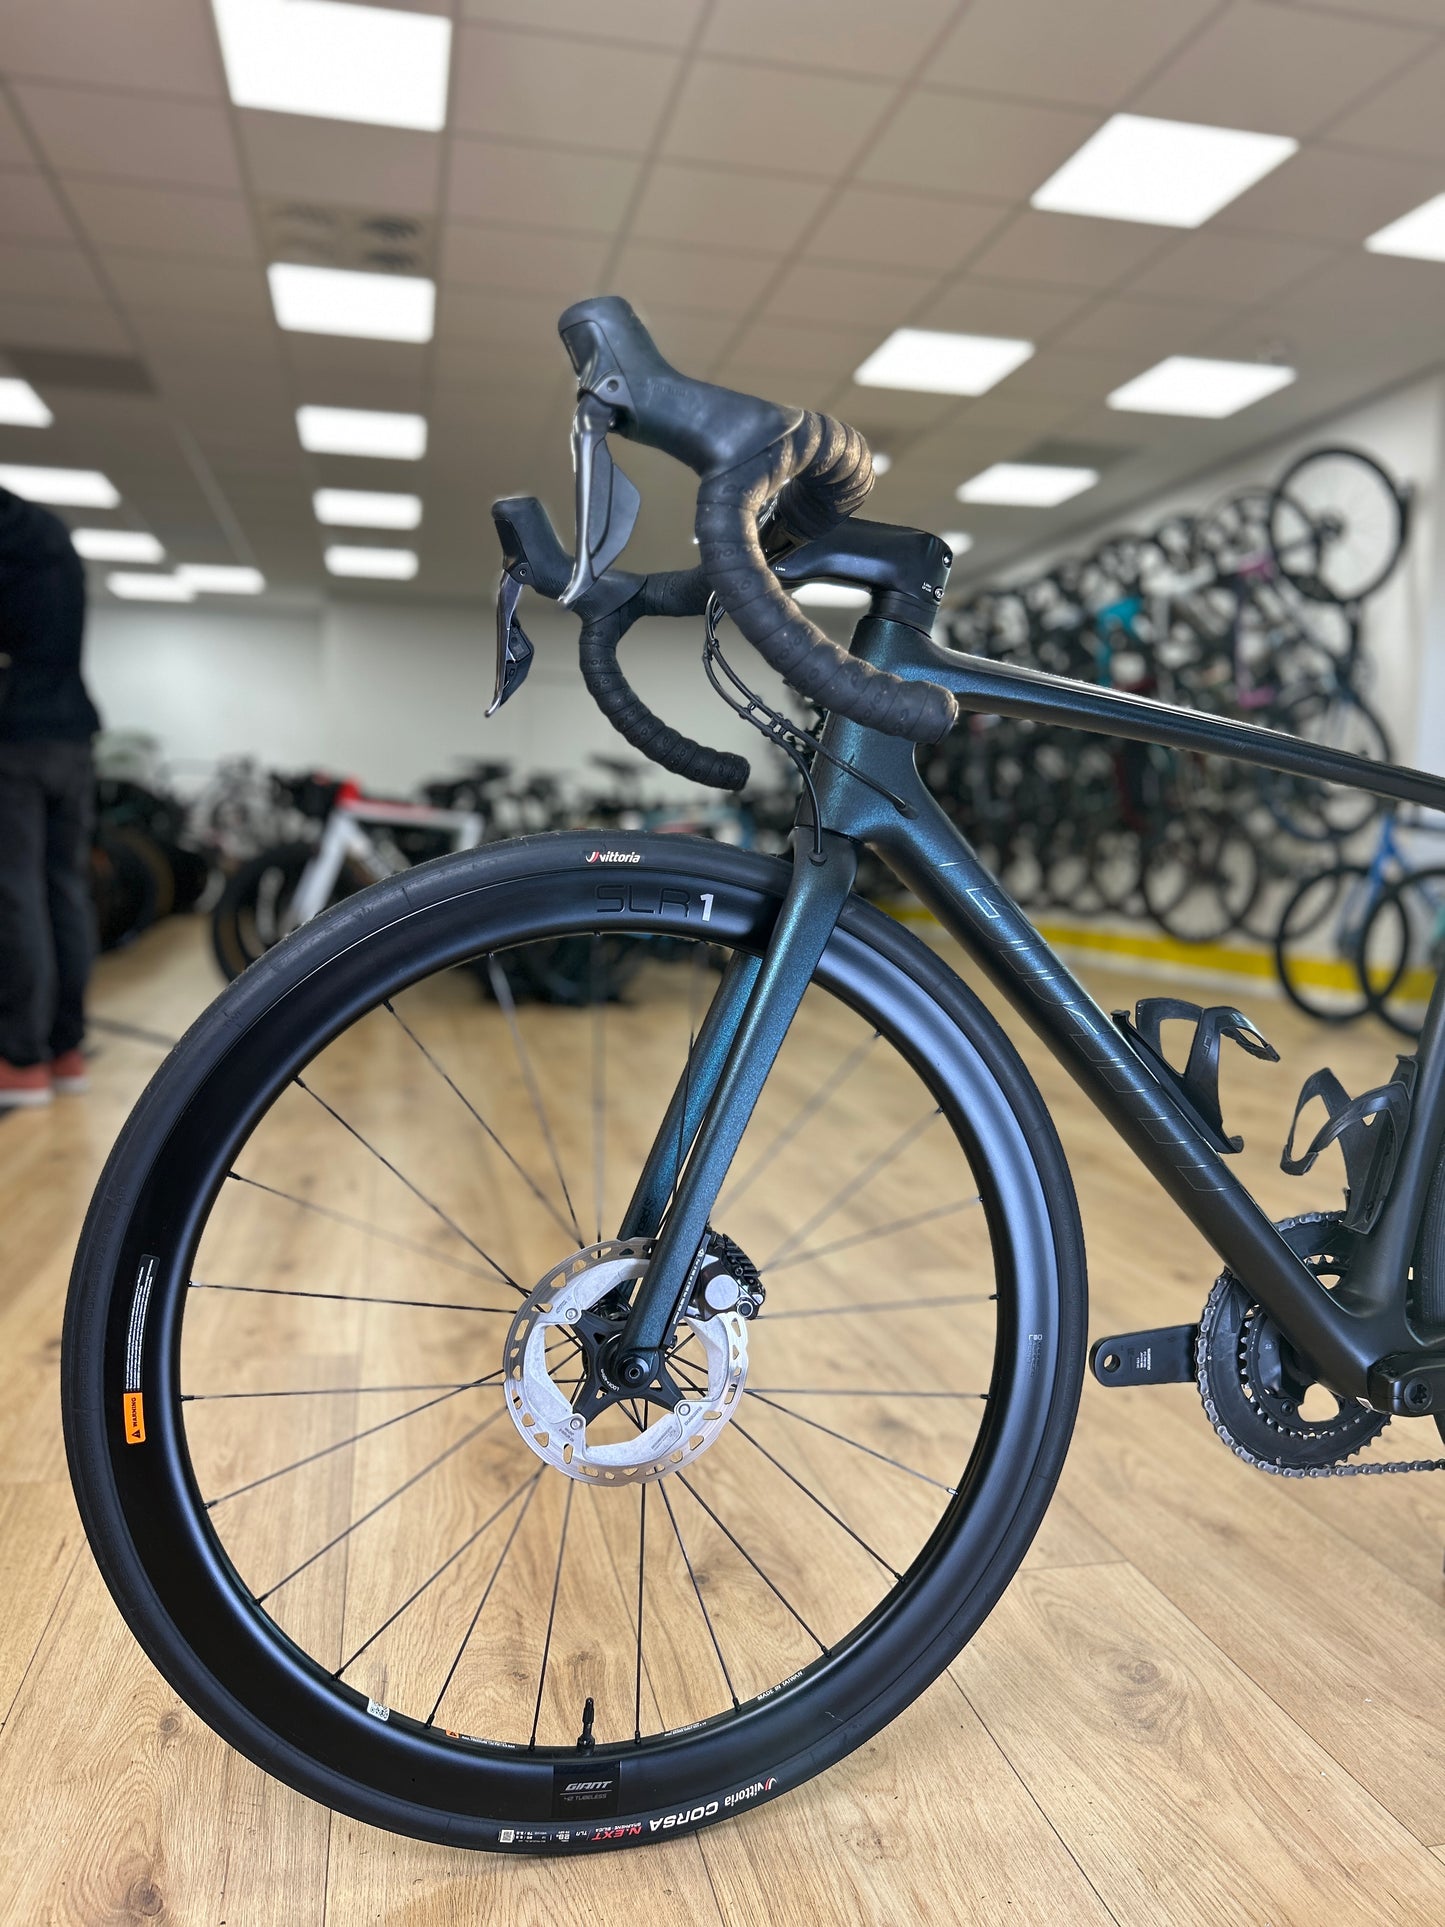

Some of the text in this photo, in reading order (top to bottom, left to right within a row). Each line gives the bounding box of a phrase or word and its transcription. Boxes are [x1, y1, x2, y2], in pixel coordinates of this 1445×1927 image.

[599, 851, 641, 864] vittoria
[595, 884, 714, 922] SLR 1
[757, 1689, 774, 1701] MADE
[782, 1670, 803, 1686] TAIWAN
[565, 1780, 613, 1791] GIANT
[724, 1782, 764, 1807] vittoria
[649, 1802, 719, 1831] CORSA
[592, 1826, 642, 1841] N.EXT
